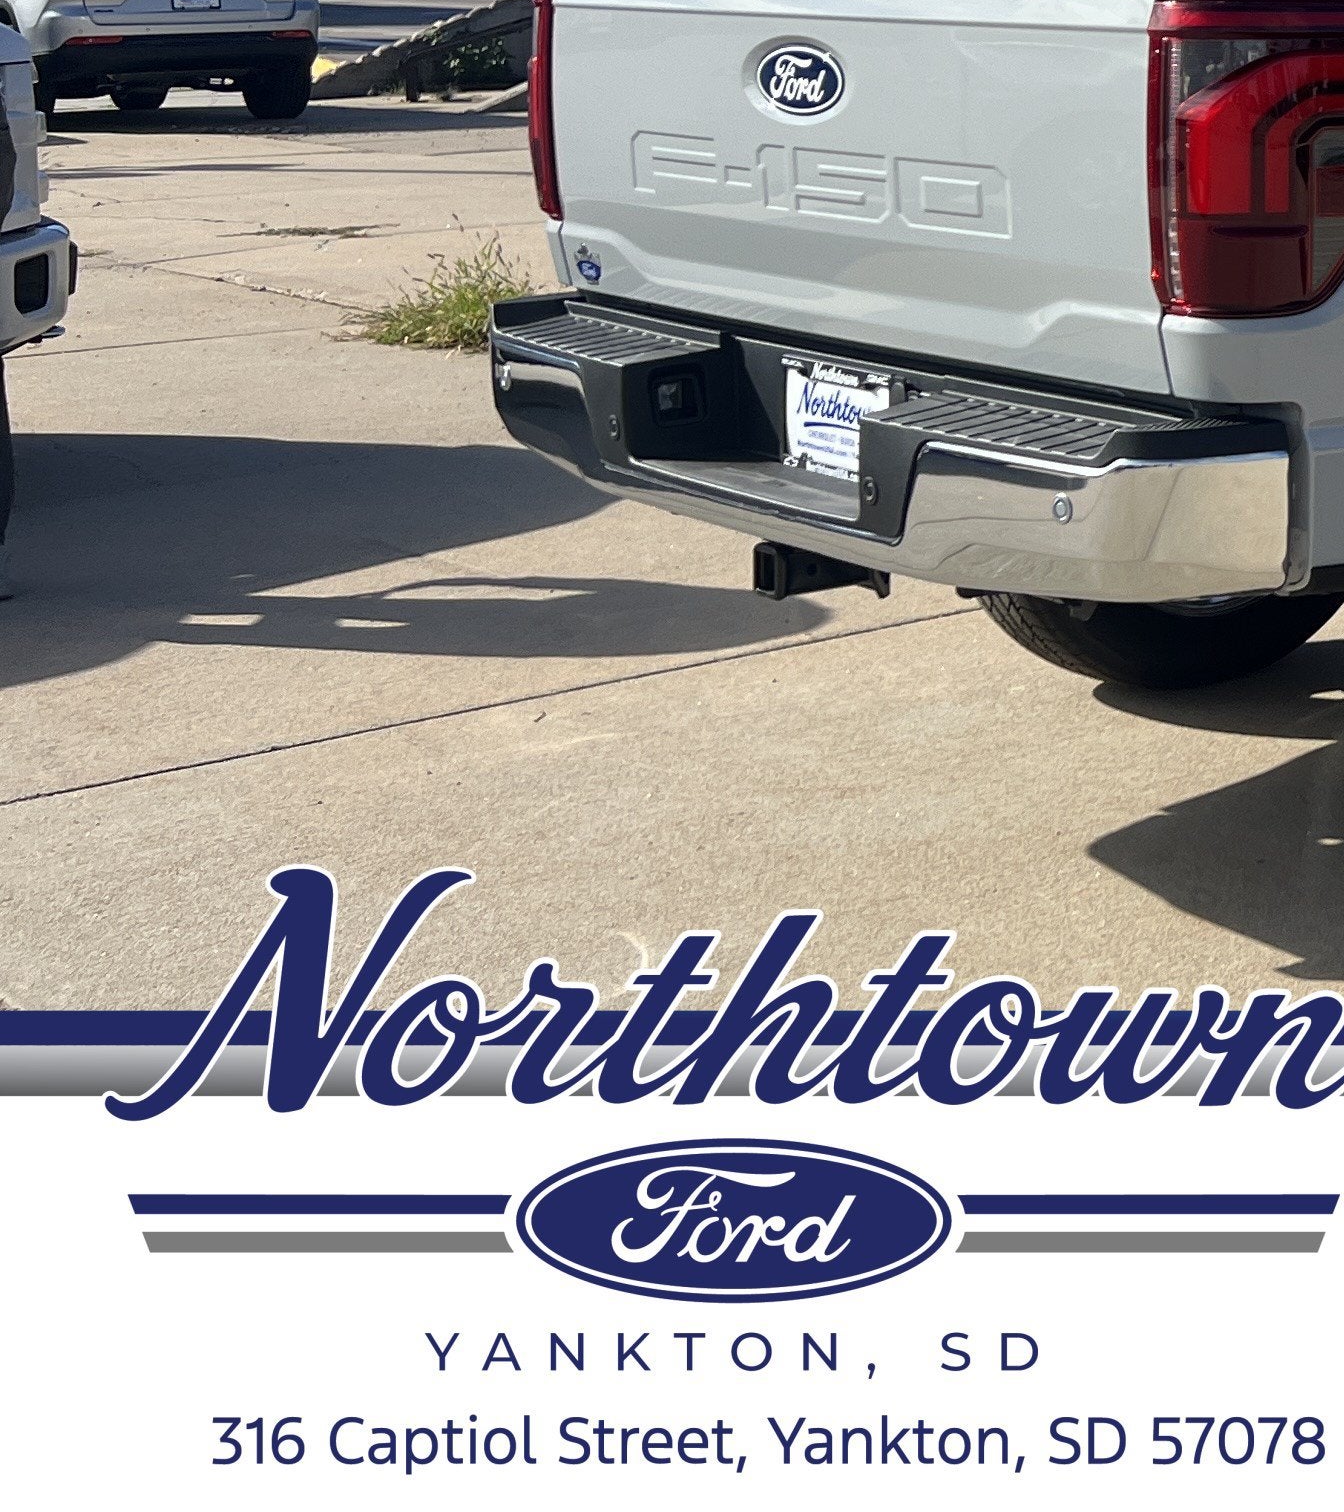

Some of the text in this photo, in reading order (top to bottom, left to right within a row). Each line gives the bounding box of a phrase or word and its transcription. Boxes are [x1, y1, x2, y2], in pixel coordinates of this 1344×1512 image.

[769, 54, 827, 103] Ford
[630, 130, 1013, 239] F-150
[796, 381, 872, 424] Northto
